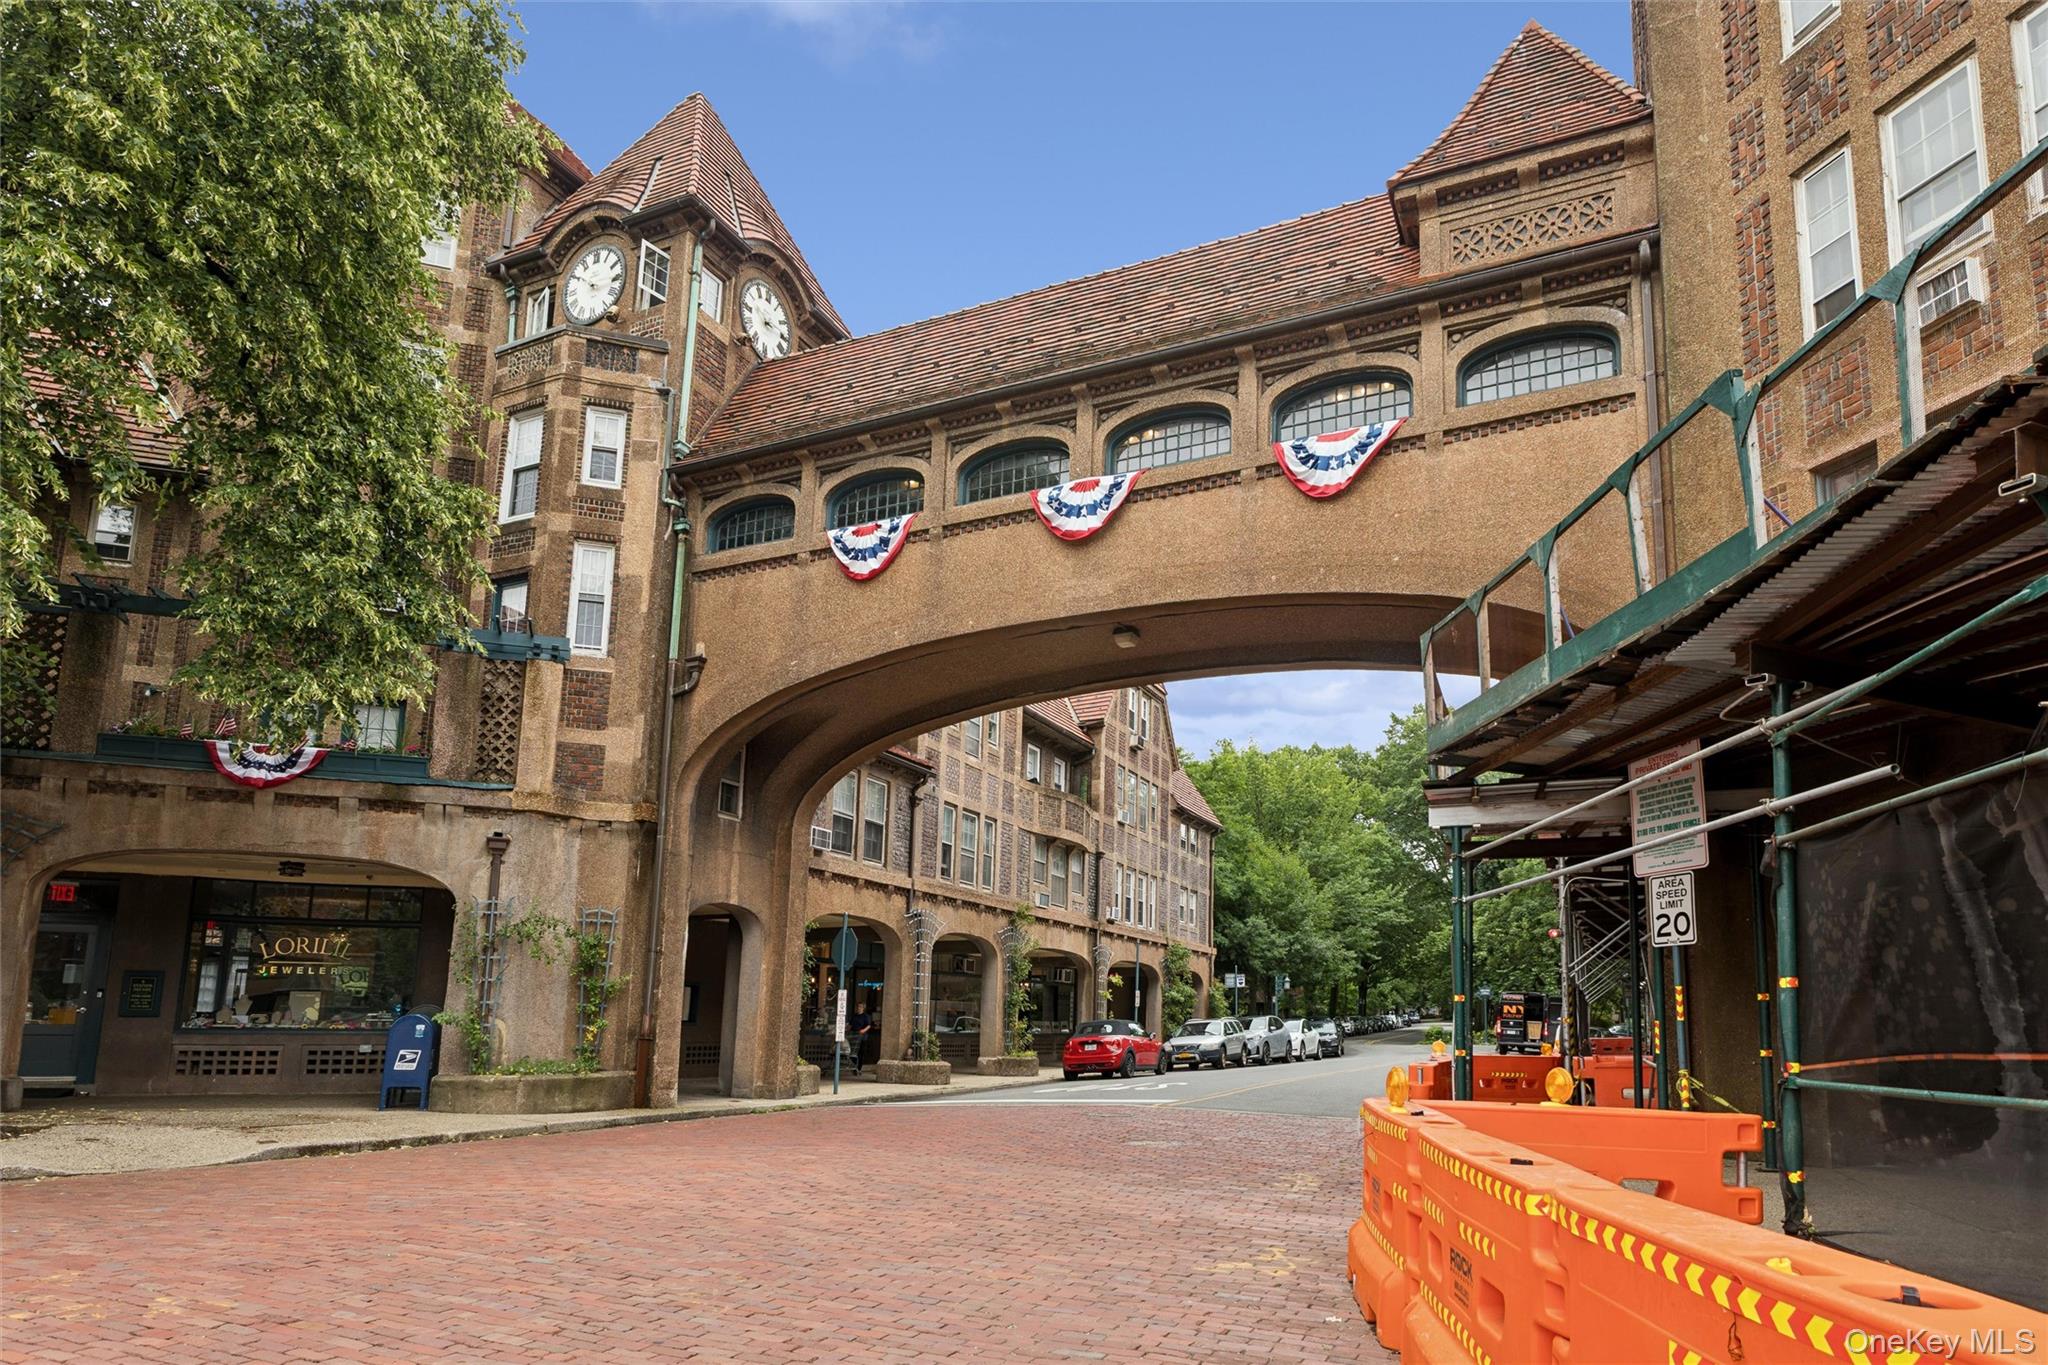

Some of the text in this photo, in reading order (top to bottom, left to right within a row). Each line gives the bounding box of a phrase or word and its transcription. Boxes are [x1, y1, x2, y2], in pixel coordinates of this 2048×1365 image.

[1658, 878, 1685, 889] AREA
[1655, 888, 1688, 900] SPEED
[1660, 898, 1684, 910] LIMIT
[1655, 911, 1691, 938] 20
[259, 965, 350, 975] JEWELERS
[1450, 1246, 1474, 1282] ROCK
